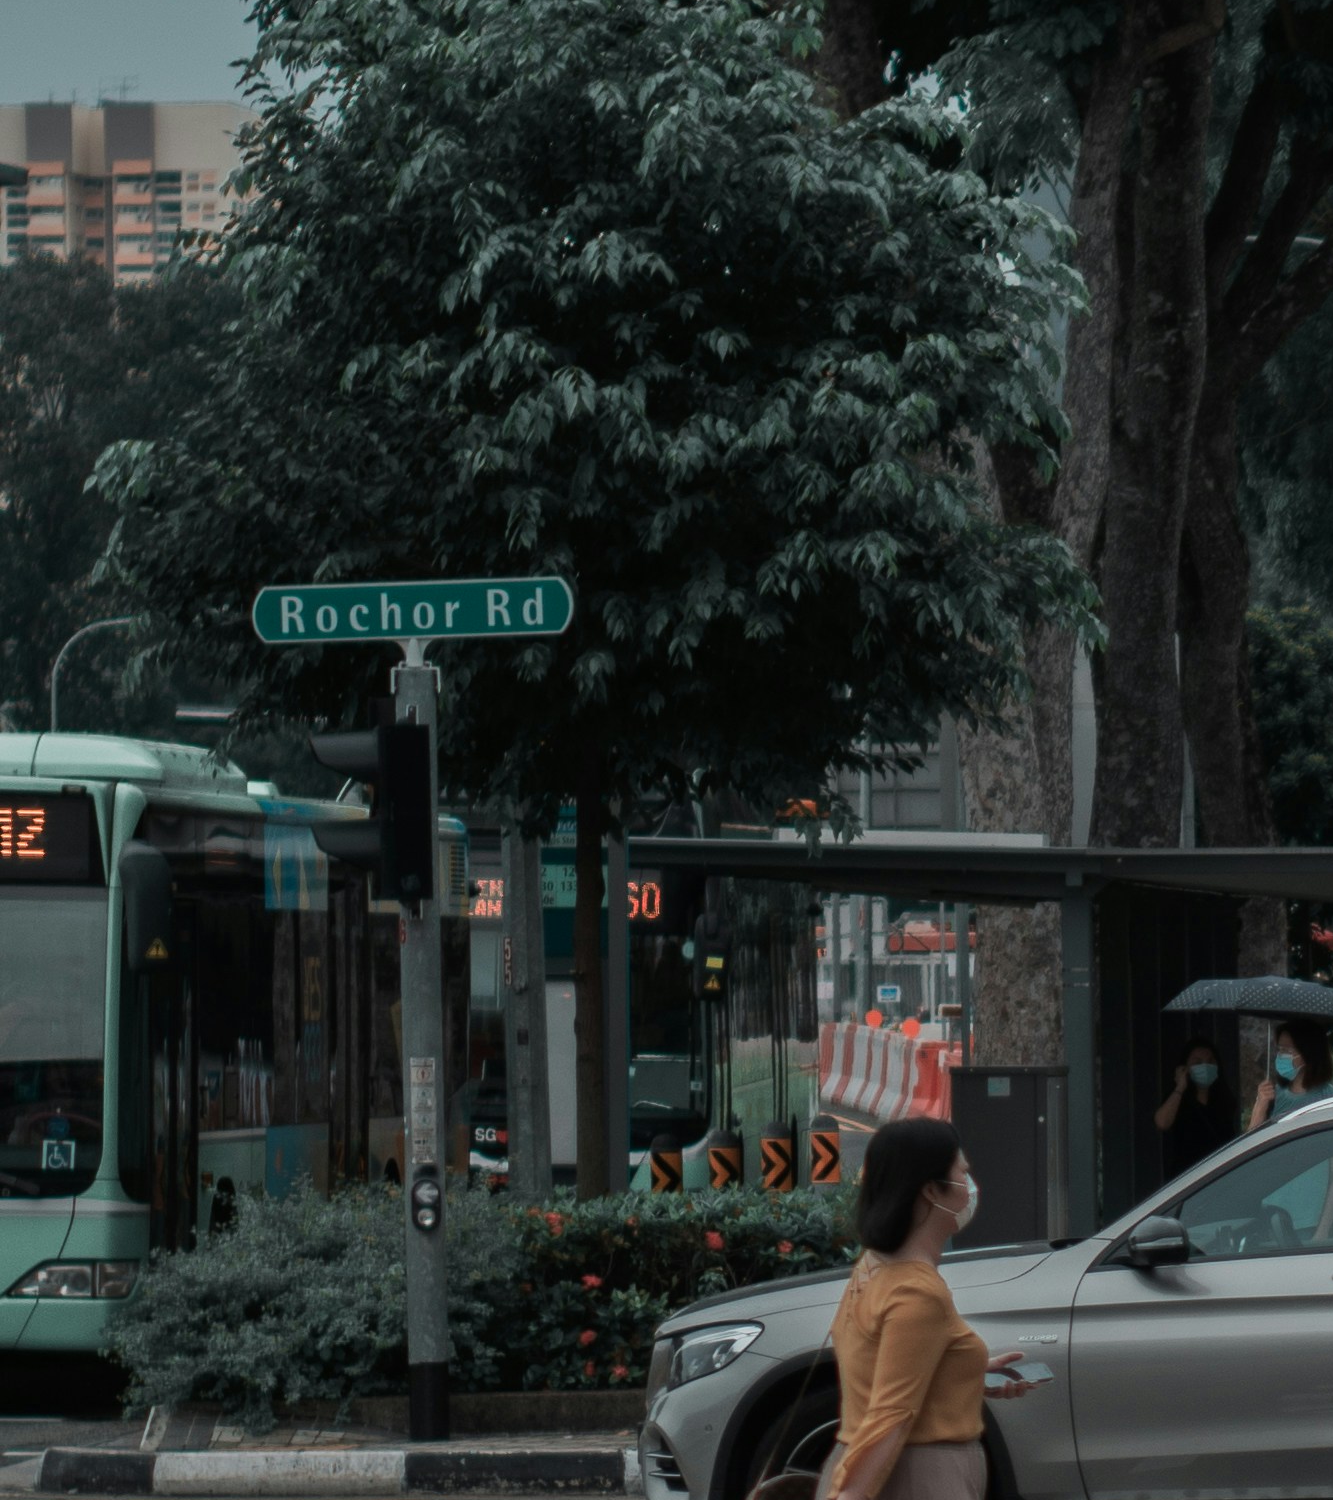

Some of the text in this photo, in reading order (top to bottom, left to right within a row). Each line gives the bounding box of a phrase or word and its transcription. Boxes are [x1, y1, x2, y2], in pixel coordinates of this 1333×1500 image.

[280, 587, 544, 634] Rochor Rd
[475, 1127, 497, 1142] SG
